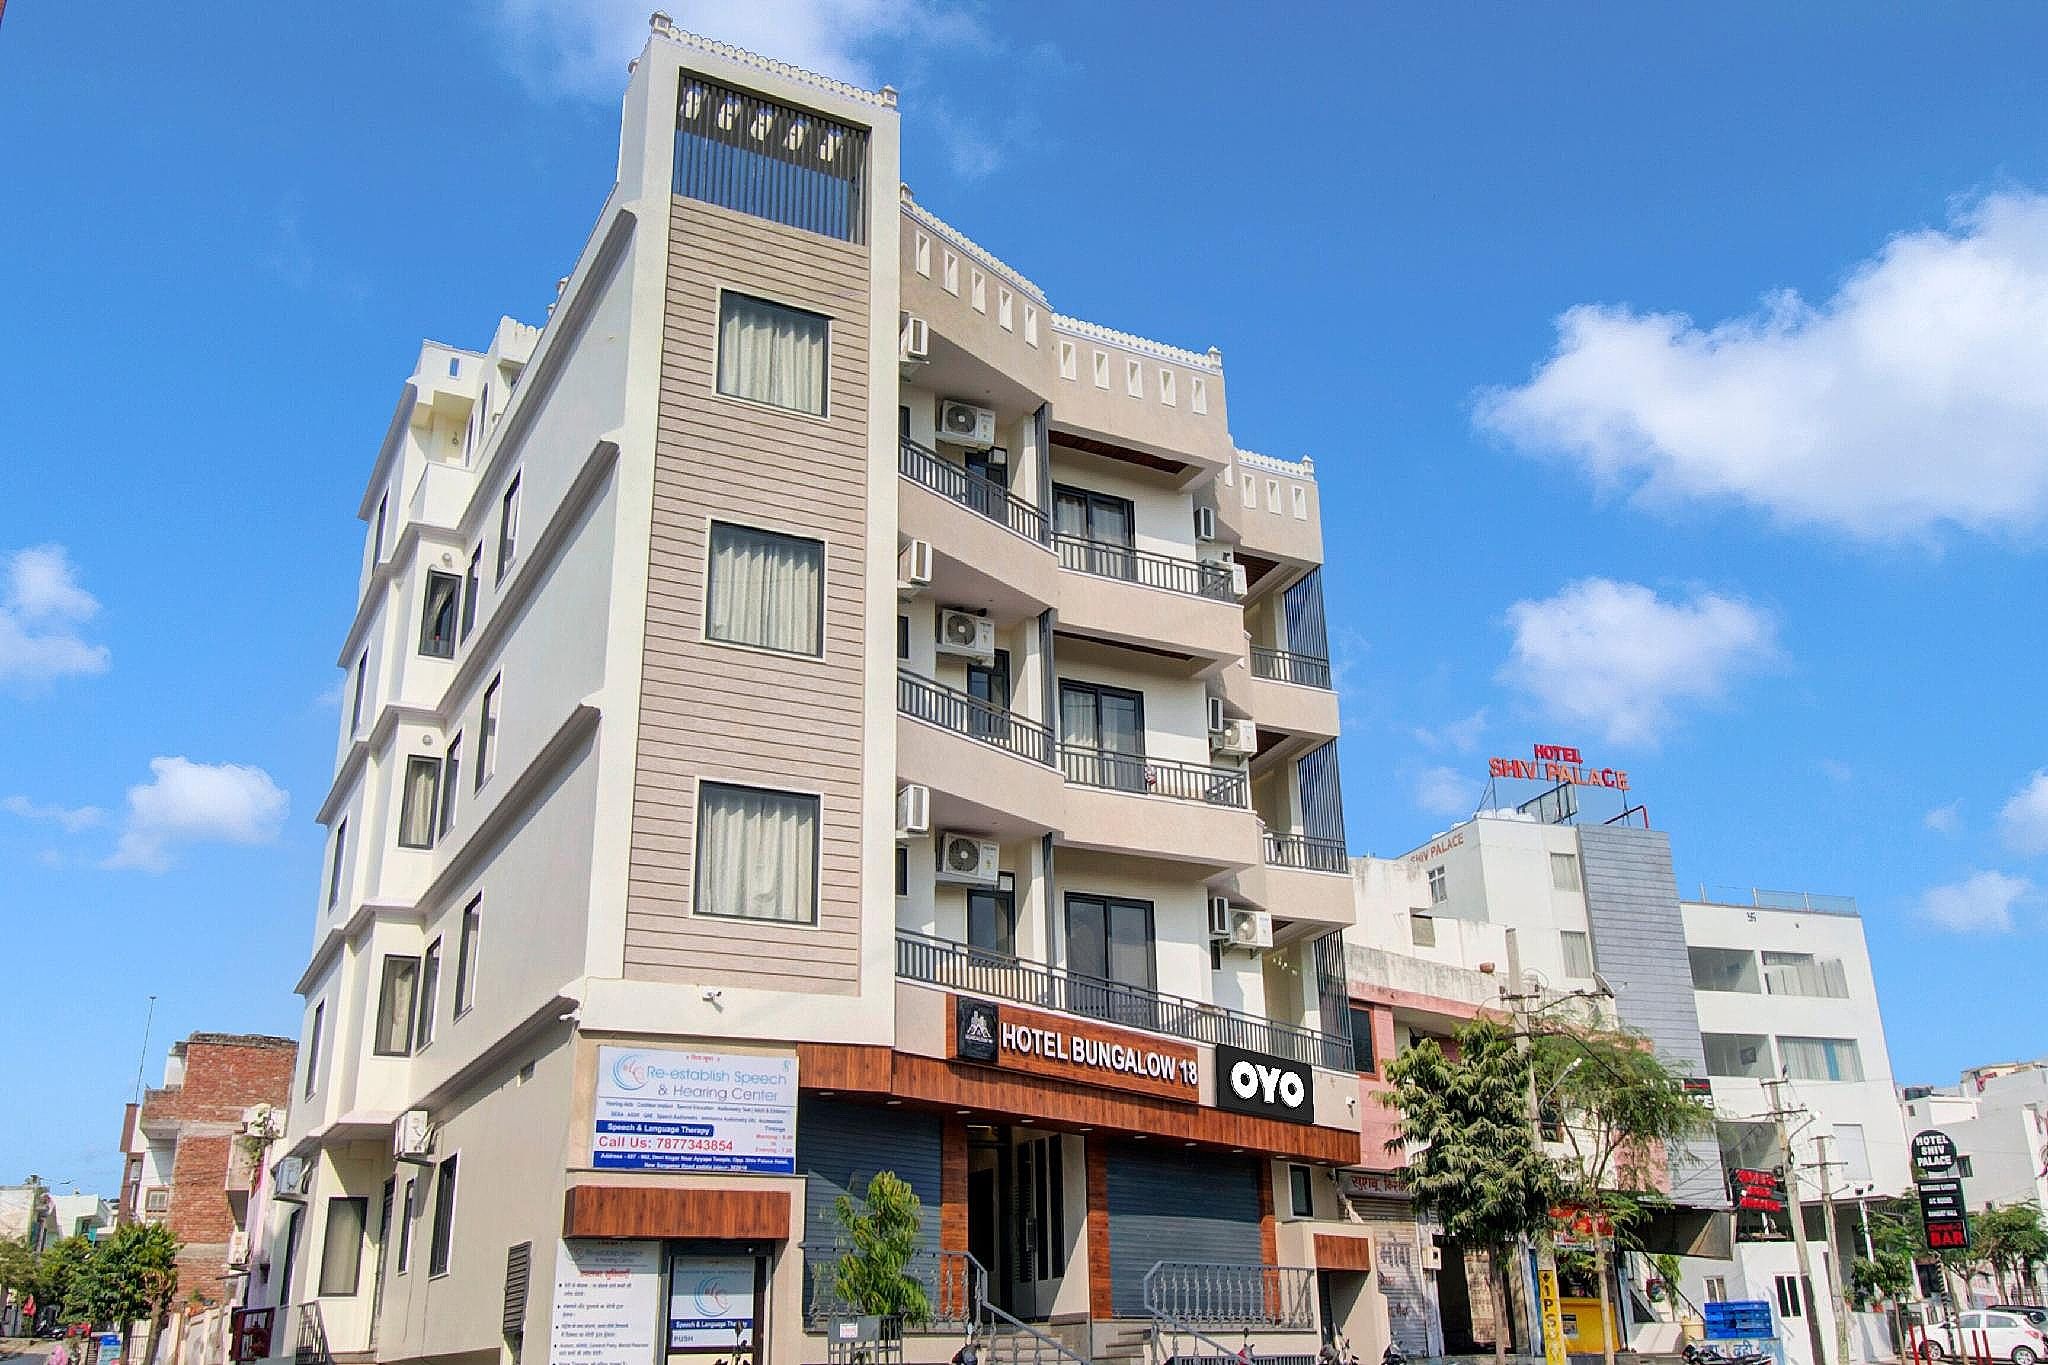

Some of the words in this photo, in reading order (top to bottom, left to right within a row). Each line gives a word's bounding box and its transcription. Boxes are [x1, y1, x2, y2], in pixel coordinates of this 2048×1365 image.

[1534, 743, 1584, 764] HOTEL
[1489, 757, 1537, 780] SHIV
[1545, 763, 1631, 790] PALACE
[1409, 850, 1429, 864] SHIV
[1430, 830, 1464, 858] PALACE
[1001, 1021, 1070, 1060] HOTEL
[1071, 1035, 1177, 1082] BUNGALOW
[1179, 1057, 1198, 1085] 18
[646, 1064, 731, 1083] Re-establish
[734, 1070, 788, 1087] Speech
[657, 1084, 668, 1096] &
[672, 1084, 729, 1102] Hearing
[731, 1087, 777, 1102] Center
[1230, 1059, 1306, 1110] OYO
[608, 1122, 635, 1132] Speech
[636, 1124, 642, 1132] &
[644, 1124, 680, 1134] Language
[681, 1125, 711, 1136] Therapy
[598, 1135, 626, 1147] Call
[629, 1136, 653, 1149] Us:
[1915, 1135, 1949, 1146] HOTEL
[1920, 1145, 1945, 1156] SHIV
[1916, 1155, 1953, 1167] PALACE
[1930, 1231, 1964, 1247] BAR
[673, 1335, 694, 1343] PUSH
